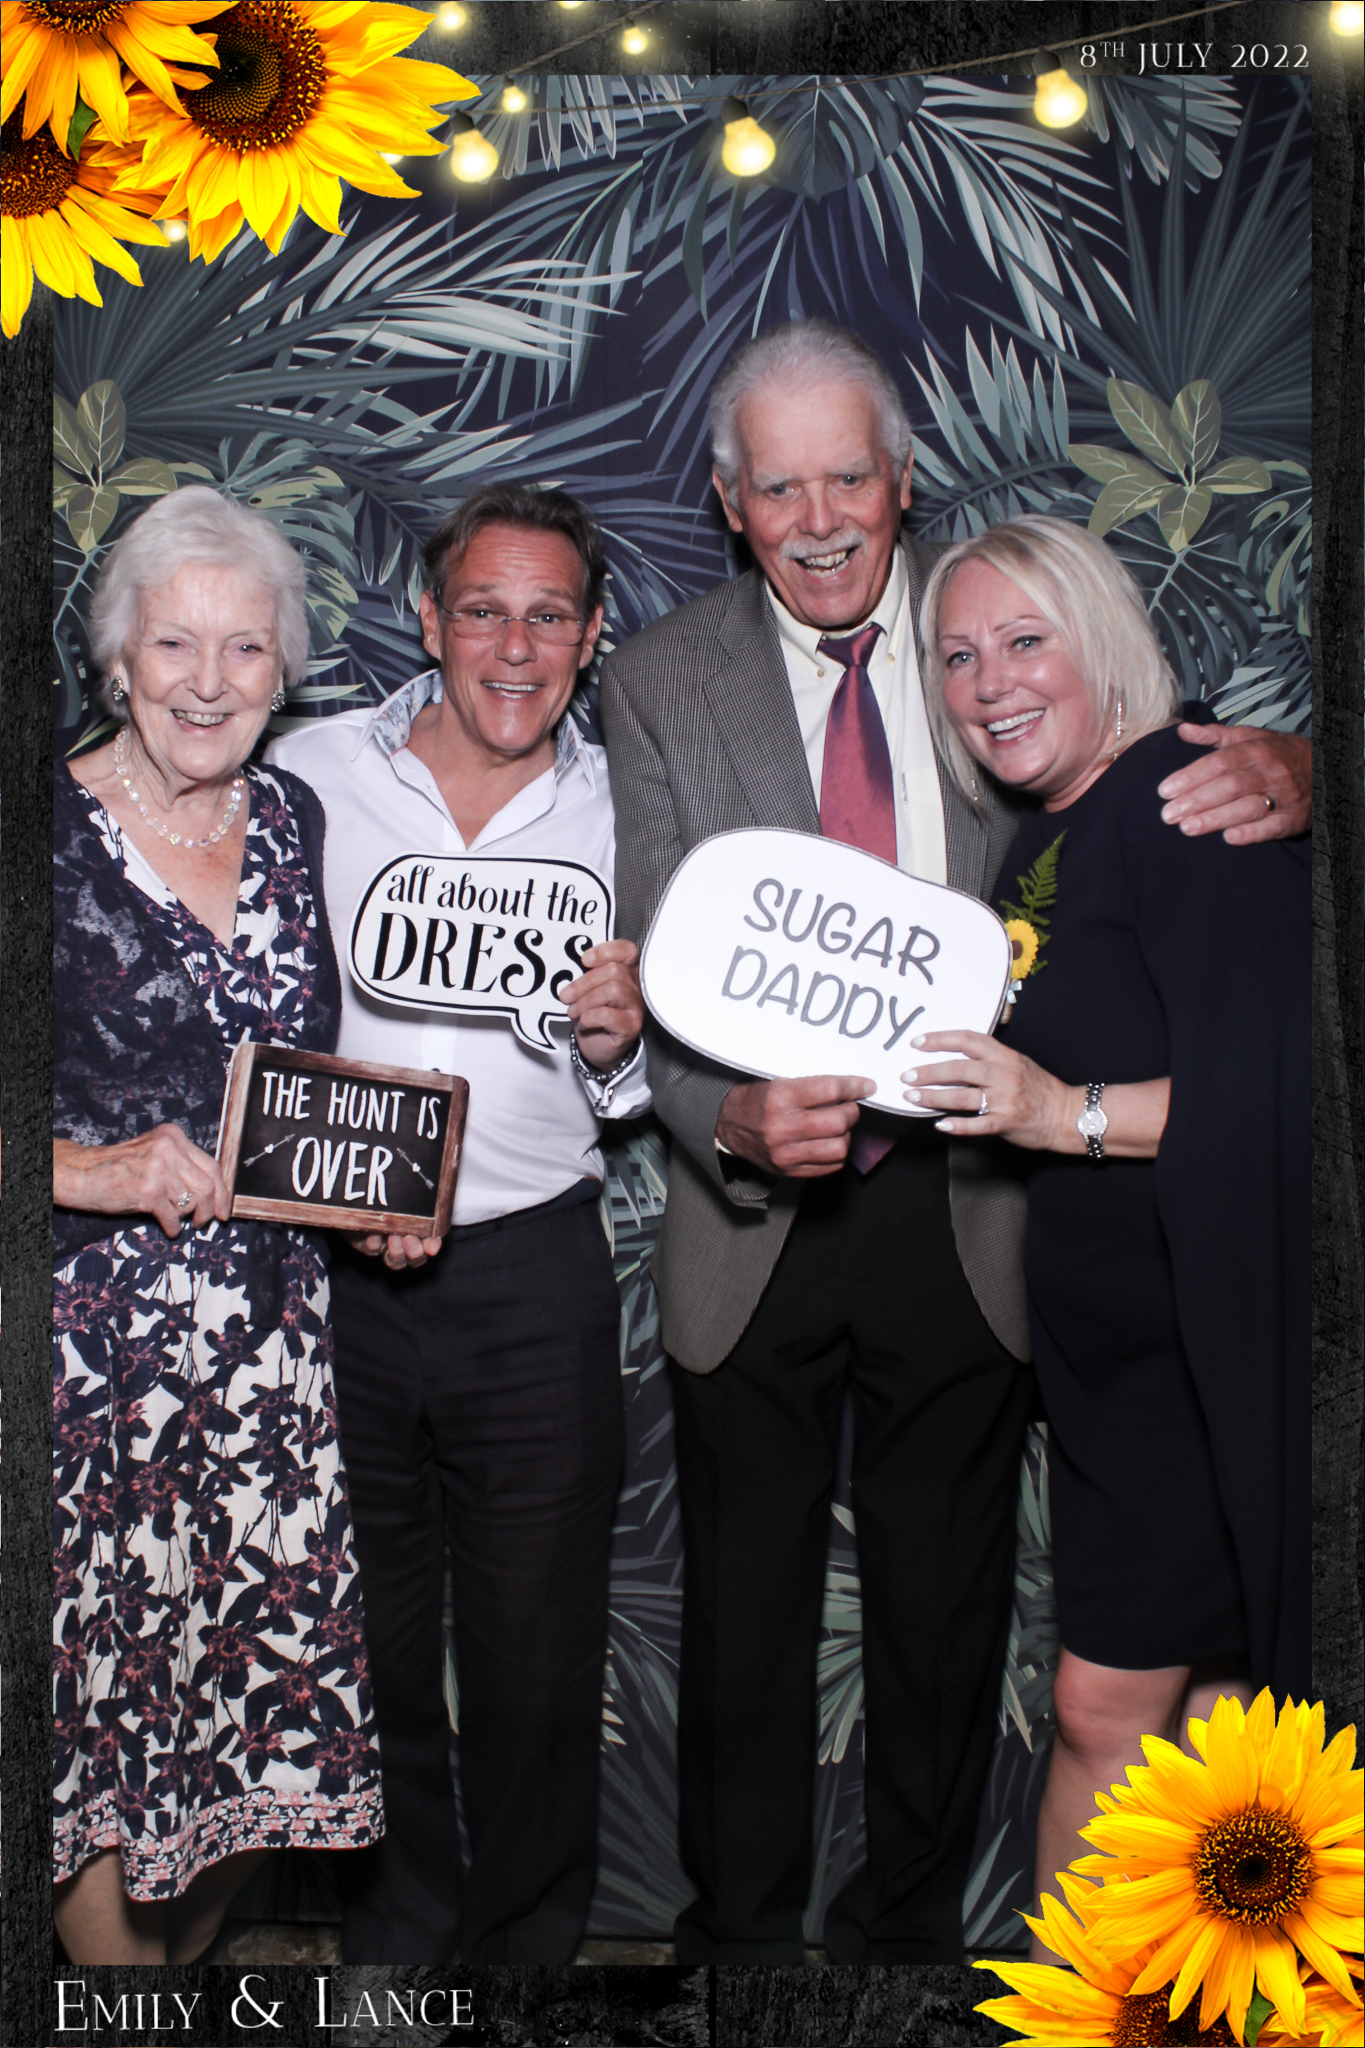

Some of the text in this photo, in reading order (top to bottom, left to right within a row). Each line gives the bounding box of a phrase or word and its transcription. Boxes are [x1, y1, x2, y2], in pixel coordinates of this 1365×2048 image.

[387, 864, 598, 926] all about the
[743, 877, 941, 986] SUGAR
[721, 945, 926, 1051] DADDY
[262, 1071, 441, 1140] THE HUNT IS
[291, 1136, 394, 1207] OVER
